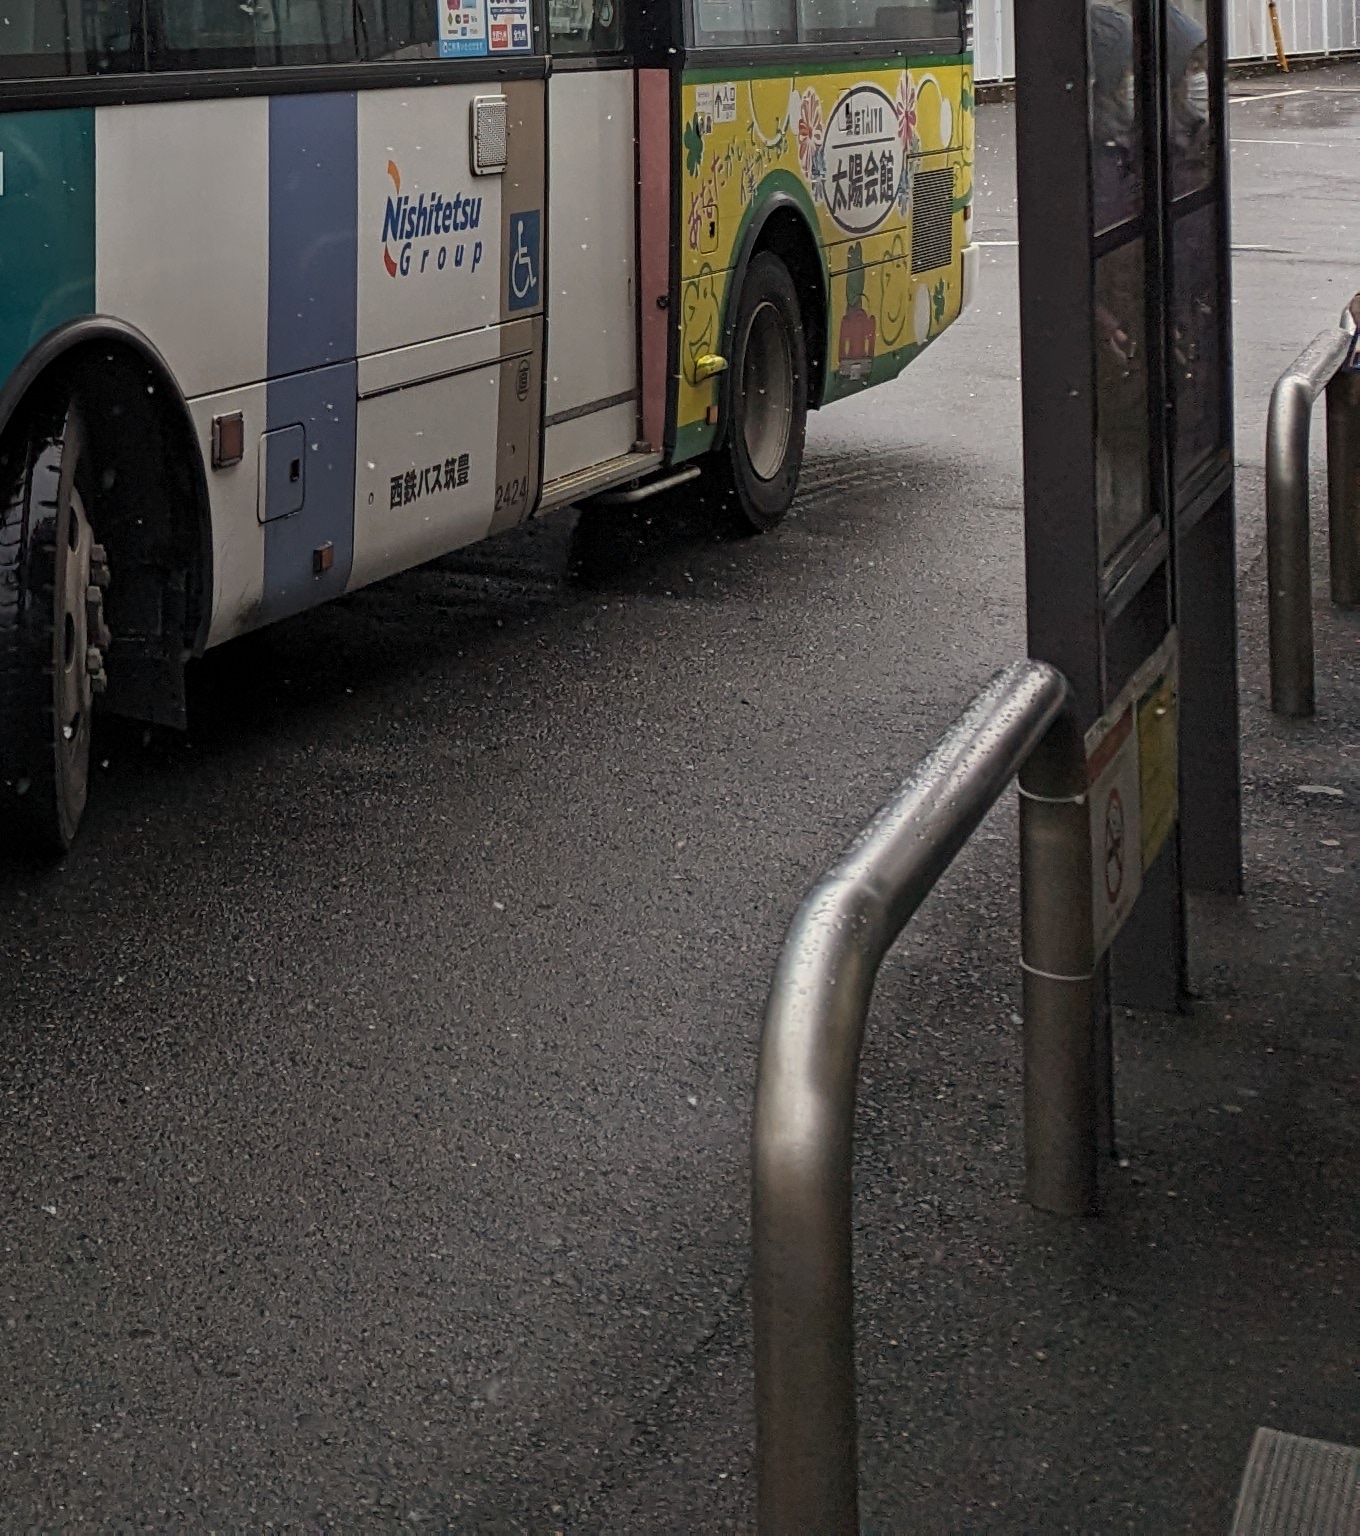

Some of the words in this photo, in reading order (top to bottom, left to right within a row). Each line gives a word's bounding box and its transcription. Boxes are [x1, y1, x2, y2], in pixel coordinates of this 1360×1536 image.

[832, 150, 895, 213] 太陽会館
[381, 191, 482, 243] Nishitetsu
[400, 241, 483, 276] Group
[390, 453, 470, 511] 西鉄バス筑豊
[494, 475, 528, 512] 2424
